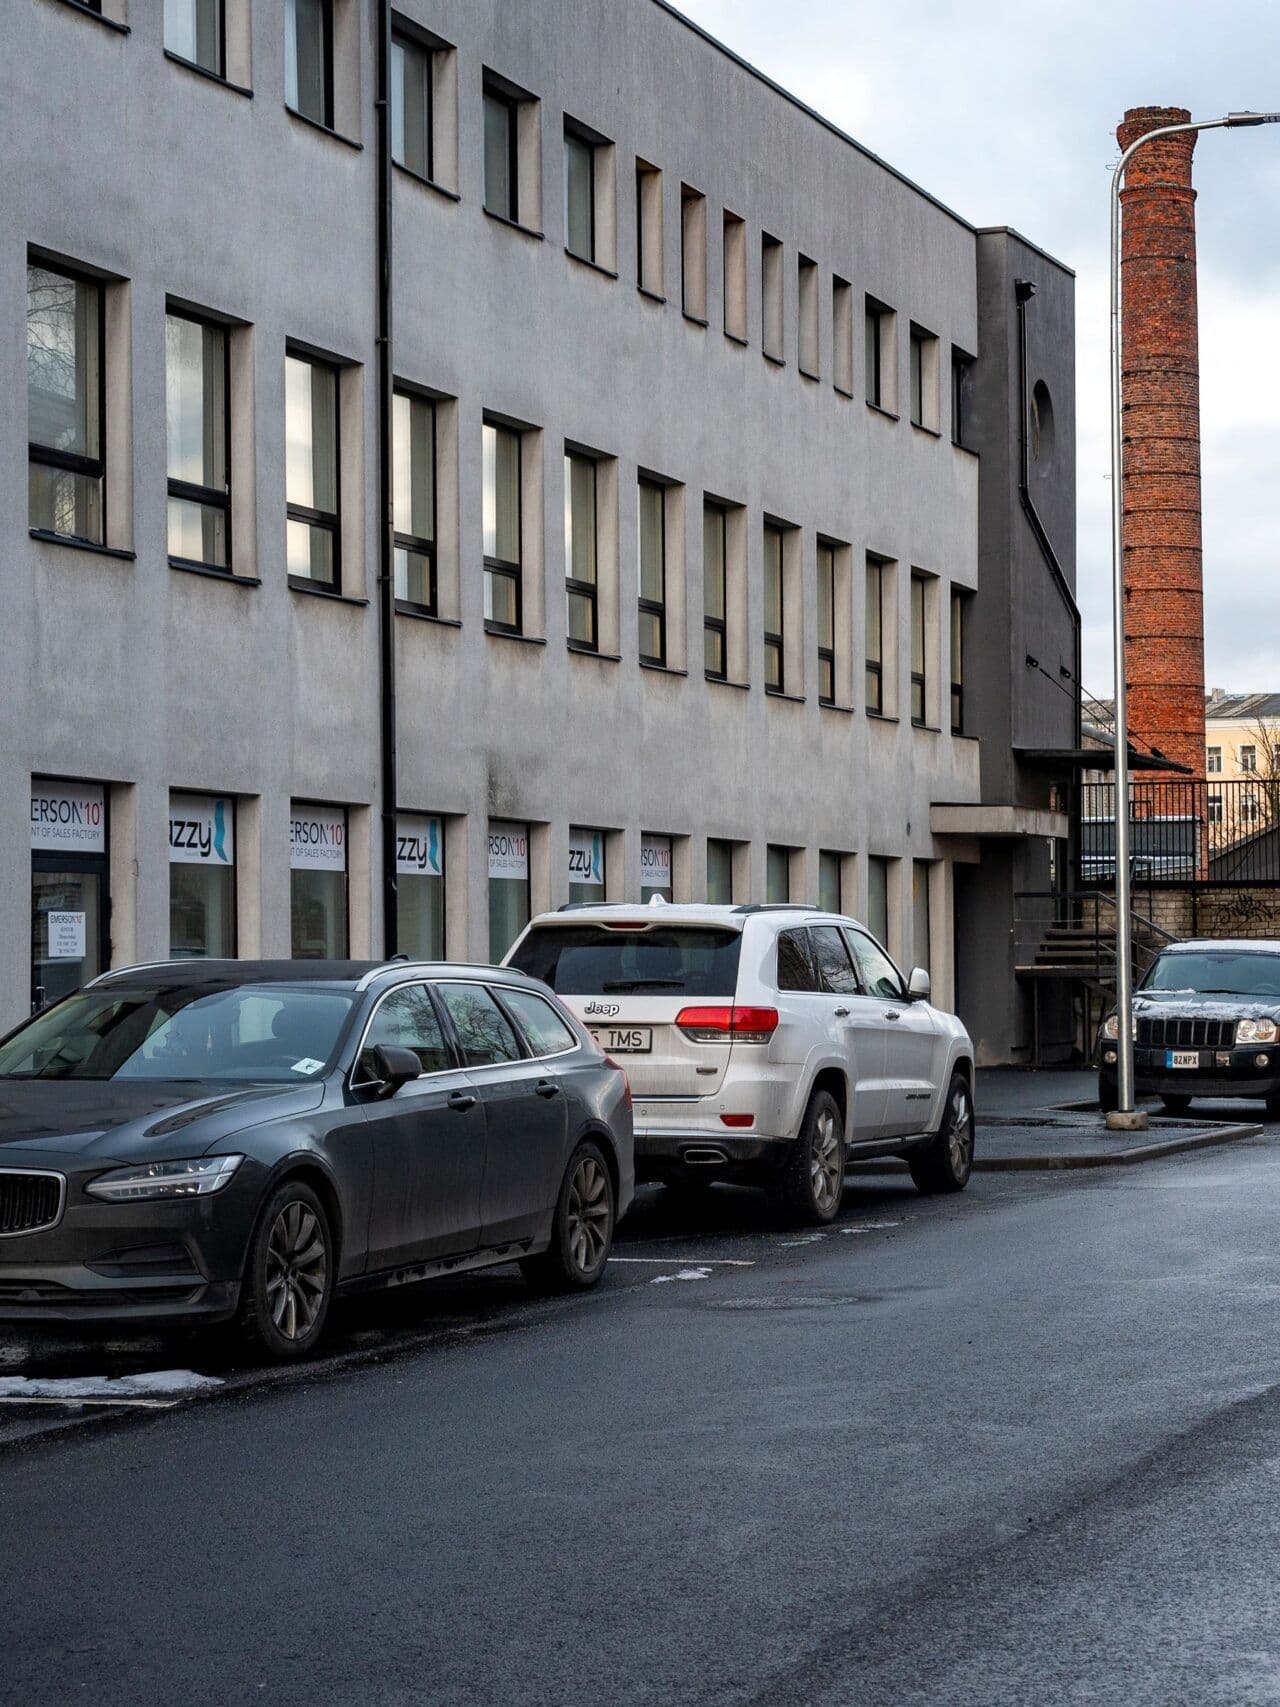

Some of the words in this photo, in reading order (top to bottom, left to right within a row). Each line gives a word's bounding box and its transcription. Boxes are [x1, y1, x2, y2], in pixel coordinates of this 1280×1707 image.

[41, 827, 51, 838] OF
[52, 828, 71, 839] SALES
[71, 829, 102, 841] FACTORY
[584, 1001, 620, 1017] Jeep
[608, 1030, 643, 1047] TMS
